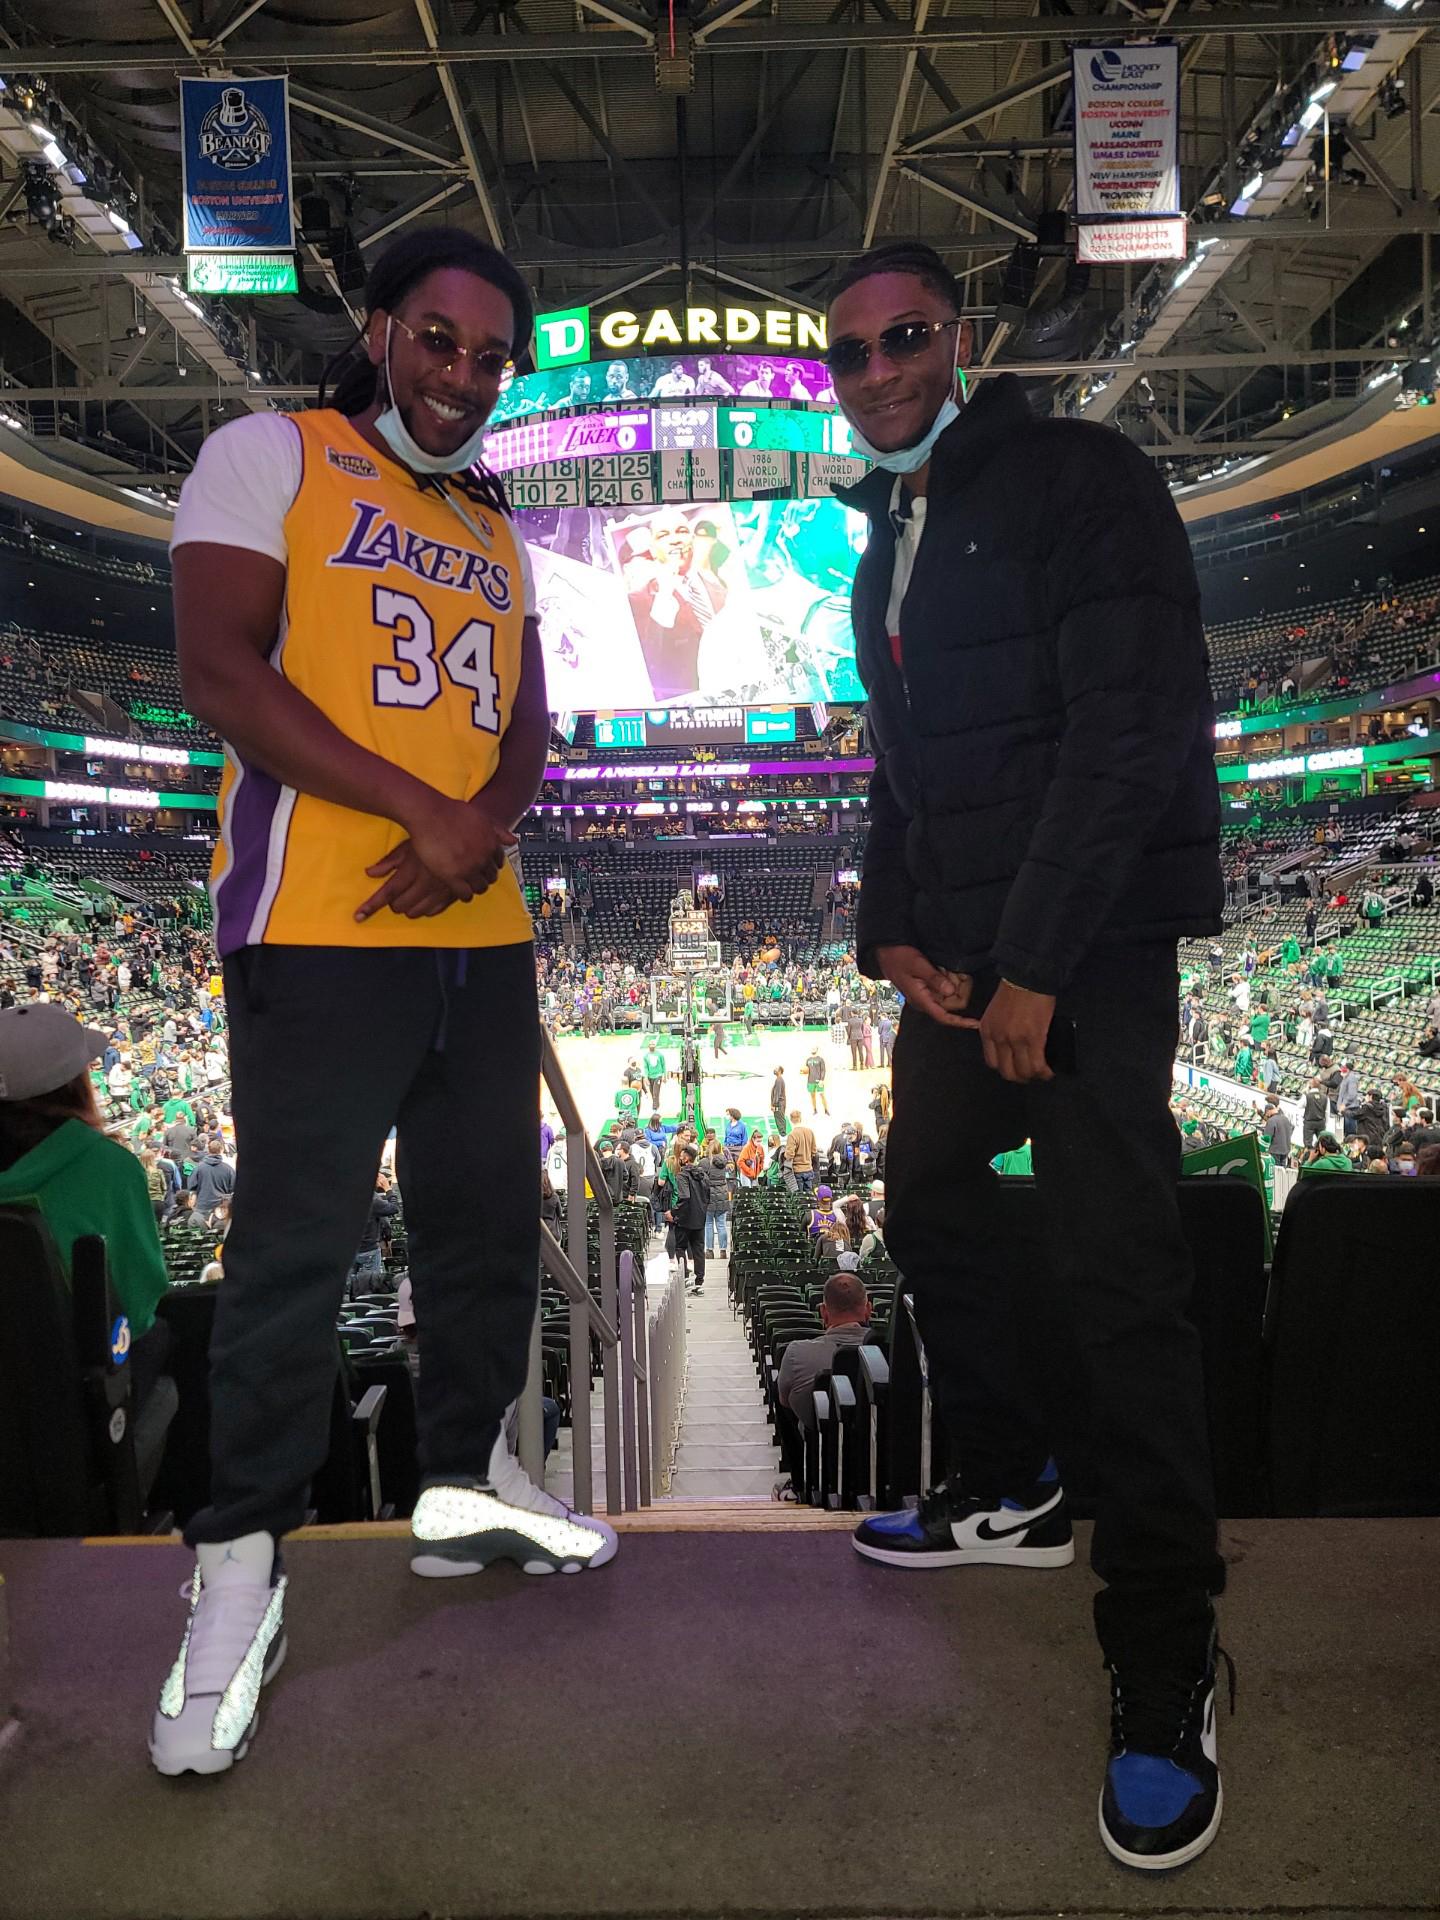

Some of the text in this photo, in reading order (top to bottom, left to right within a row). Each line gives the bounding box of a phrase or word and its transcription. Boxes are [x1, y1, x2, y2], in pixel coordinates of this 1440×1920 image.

[1121, 71, 1145, 79] EAST
[1092, 82, 1162, 91] CHAMPIONSHIP
[1088, 99, 1164, 109] BOSTON COLLEGE
[1112, 131, 1141, 139] MAINE
[202, 132, 269, 155] BEANPOT
[1093, 150, 1160, 159] UMASS LOWELL
[1090, 170, 1162, 180] NEW HAMPSHIRE
[1100, 191, 1154, 200] PROVIDENCE
[540, 307, 829, 357] TD GARDEN
[564, 424, 619, 452] LAKER
[734, 423, 753, 447] 0
[752, 454, 772, 464] 1986
[551, 459, 573, 477] 18
[592, 455, 650, 478] 21 25
[747, 466, 777, 476] WORLD
[822, 465, 853, 475] WORLD
[737, 477, 787, 488] CHAMPIONS
[516, 484, 540, 503] 10
[555, 483, 568, 502] 2
[591, 482, 644, 502] 24 6
[328, 500, 514, 615] LAKERS
[372, 583, 501, 737] 34
[565, 767, 601, 779] LOS
[680, 763, 751, 776] LAKERS
